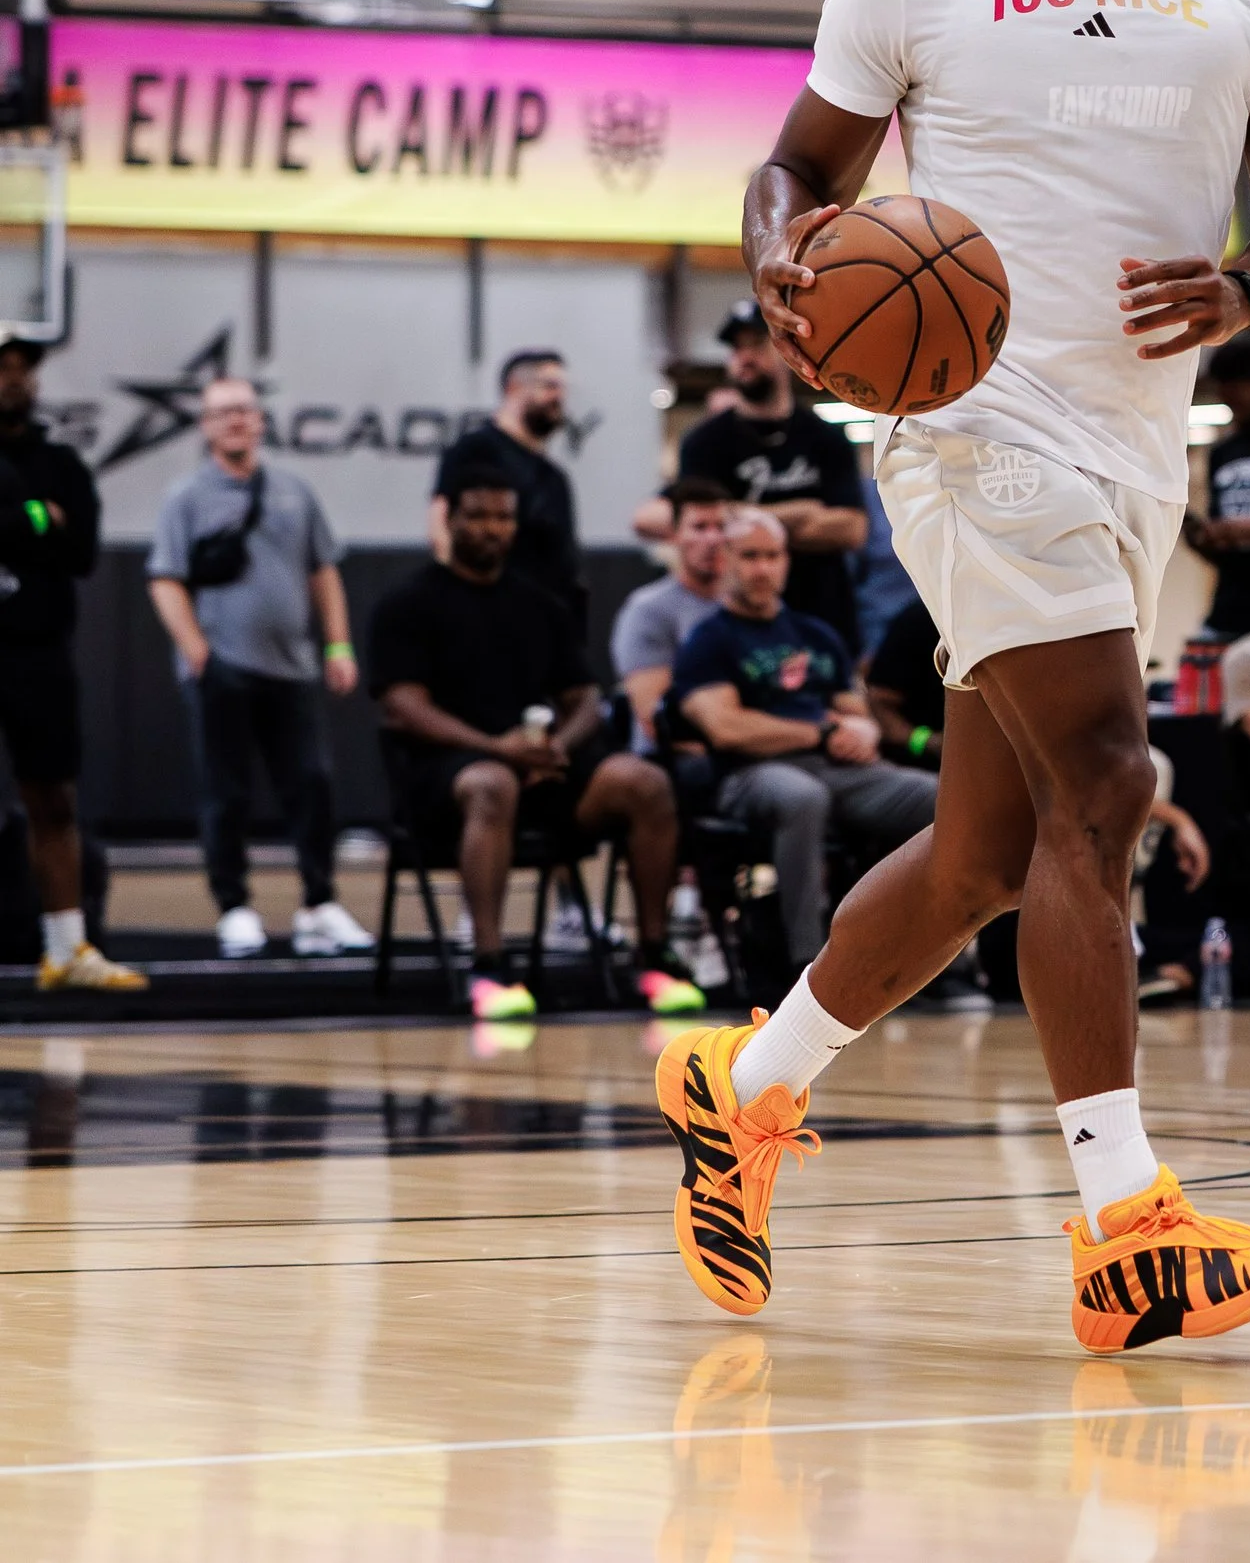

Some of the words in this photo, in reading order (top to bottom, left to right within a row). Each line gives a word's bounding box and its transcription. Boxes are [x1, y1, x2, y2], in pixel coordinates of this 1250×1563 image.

[121, 71, 317, 174] ELITE
[346, 78, 549, 181] CAMP
[262, 403, 604, 457] CADY
